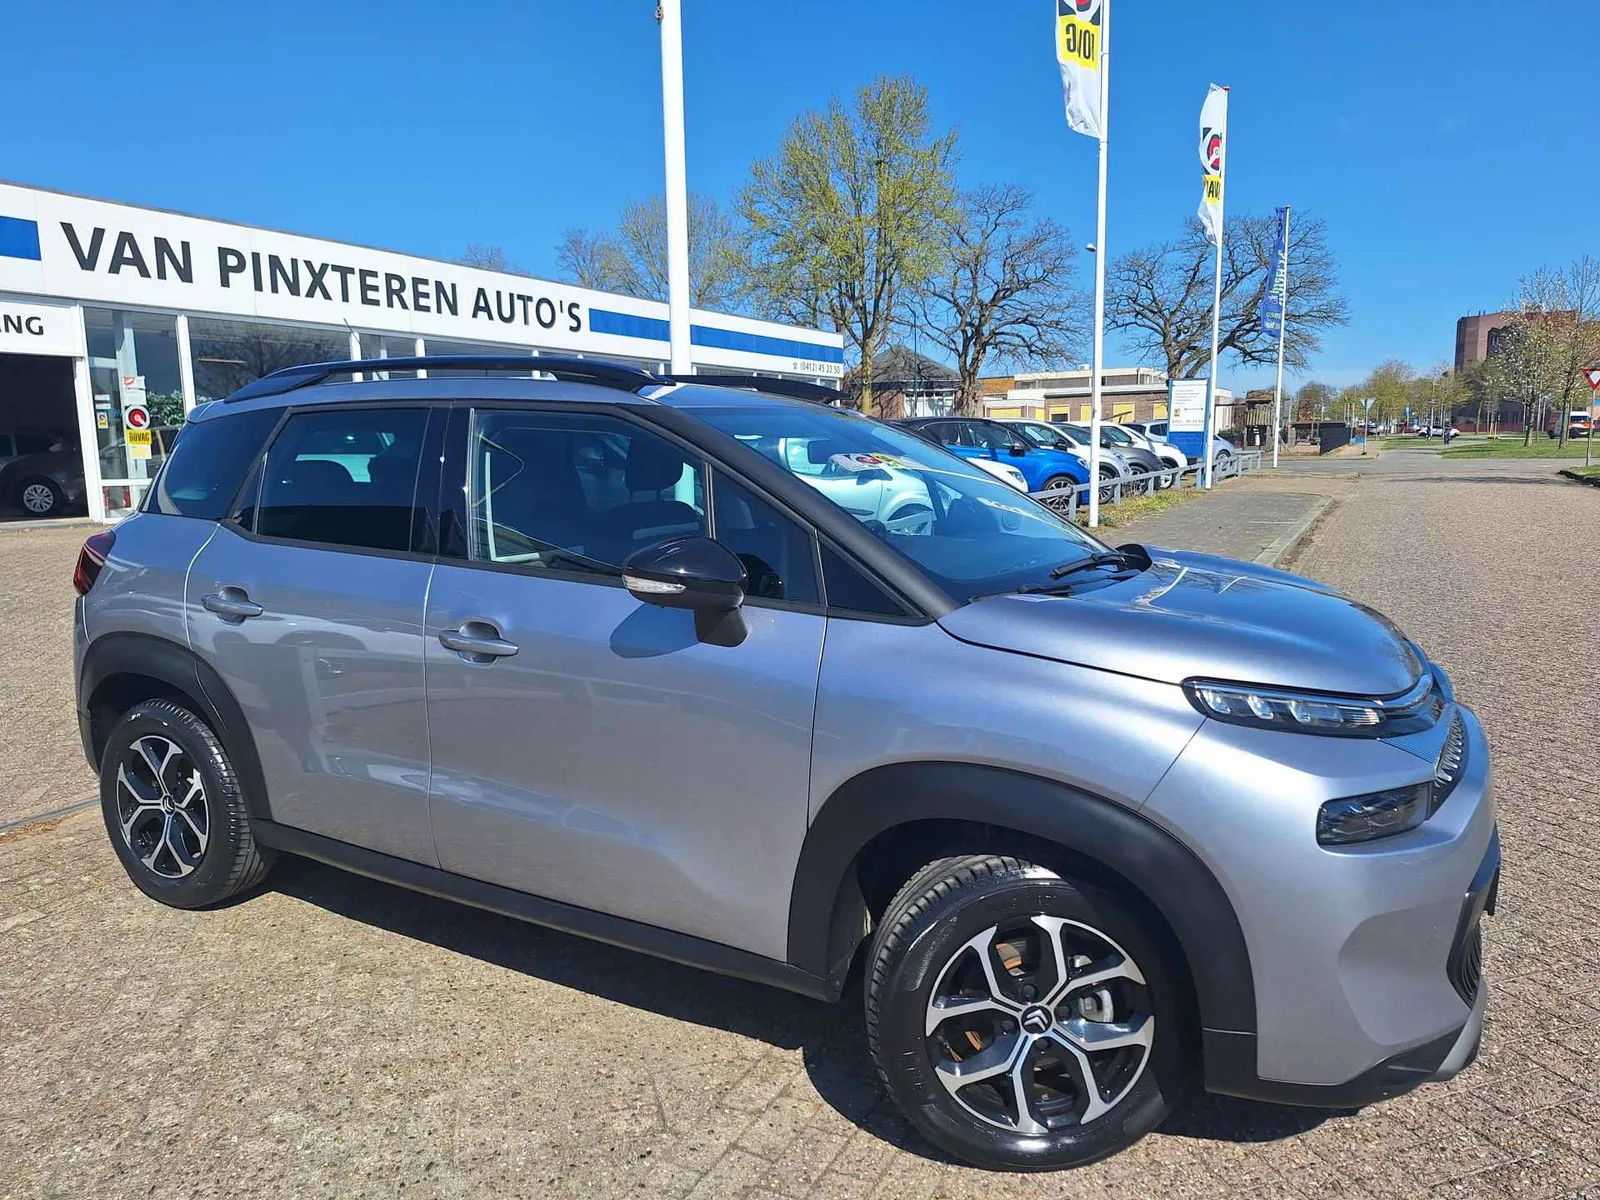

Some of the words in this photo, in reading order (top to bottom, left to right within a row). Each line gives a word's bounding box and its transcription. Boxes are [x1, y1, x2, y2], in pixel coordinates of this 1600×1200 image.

[60, 221, 194, 284] VAN
[217, 246, 459, 317] PINXTEREN
[471, 287, 583, 333] AUTO'S
[0, 314, 44, 336] NG
[818, 364, 825, 373] 45
[826, 364, 833, 374] 22
[834, 365, 841, 375] 50
